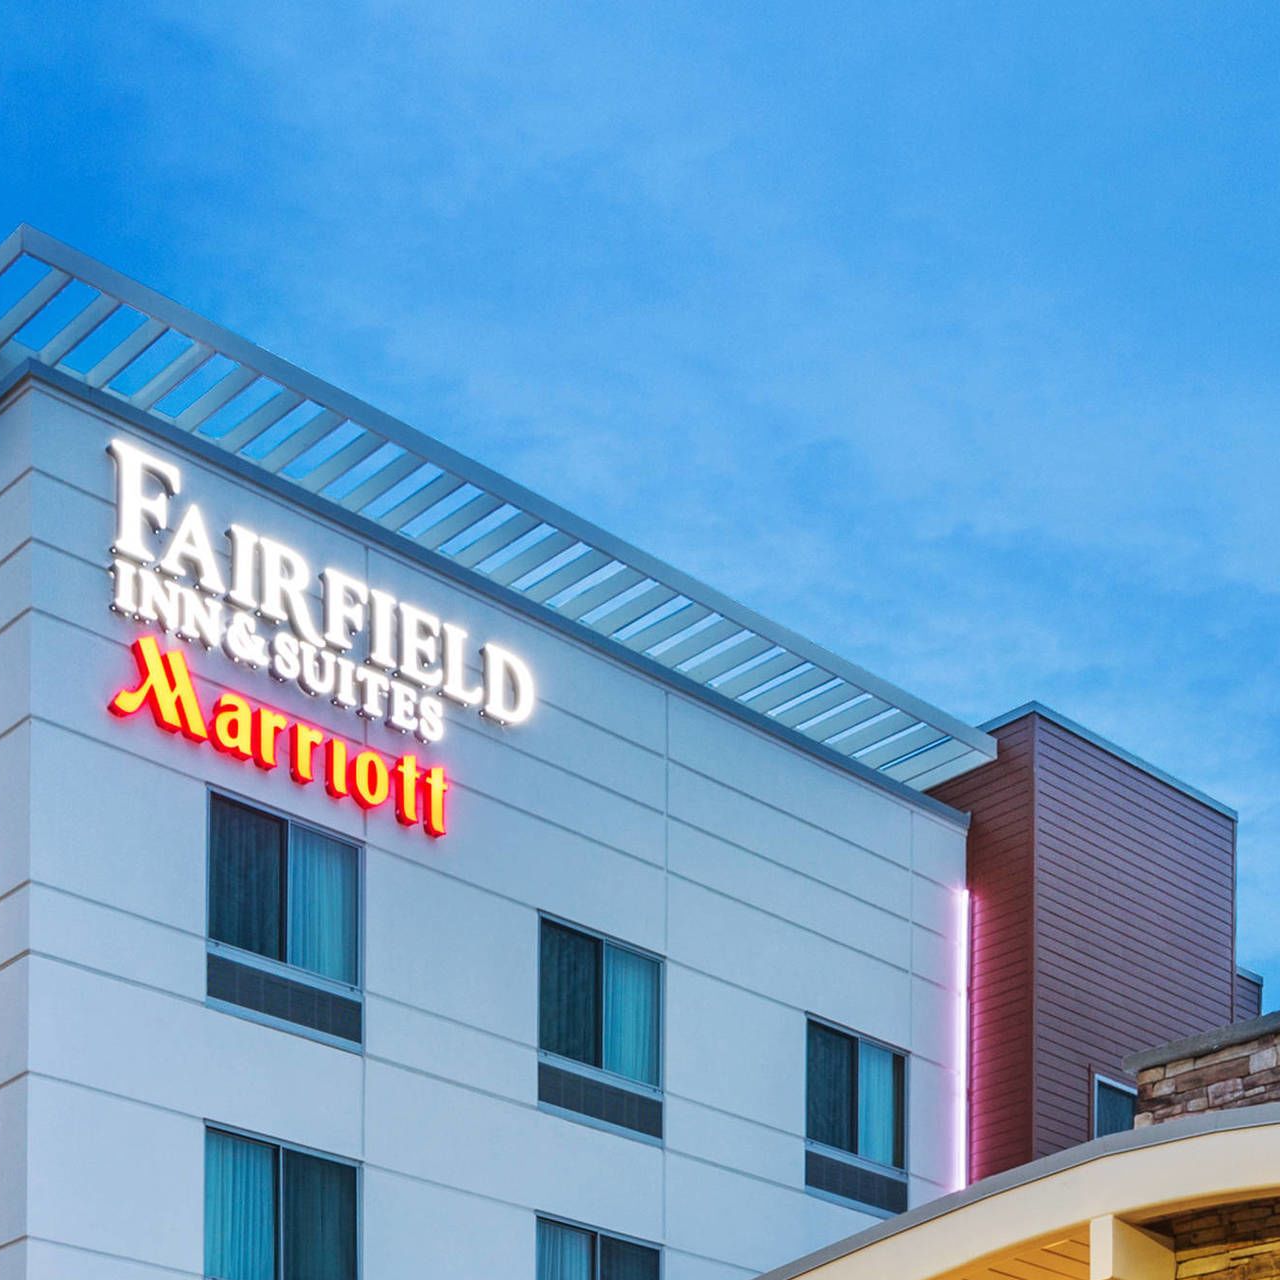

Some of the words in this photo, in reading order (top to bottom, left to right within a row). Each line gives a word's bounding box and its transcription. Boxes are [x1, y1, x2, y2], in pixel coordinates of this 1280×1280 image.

[108, 440, 535, 727] FAIRFIELD
[110, 559, 222, 651] INN
[226, 613, 270, 669] &
[269, 634, 444, 743] SUITES
[107, 635, 449, 838] Marriott
